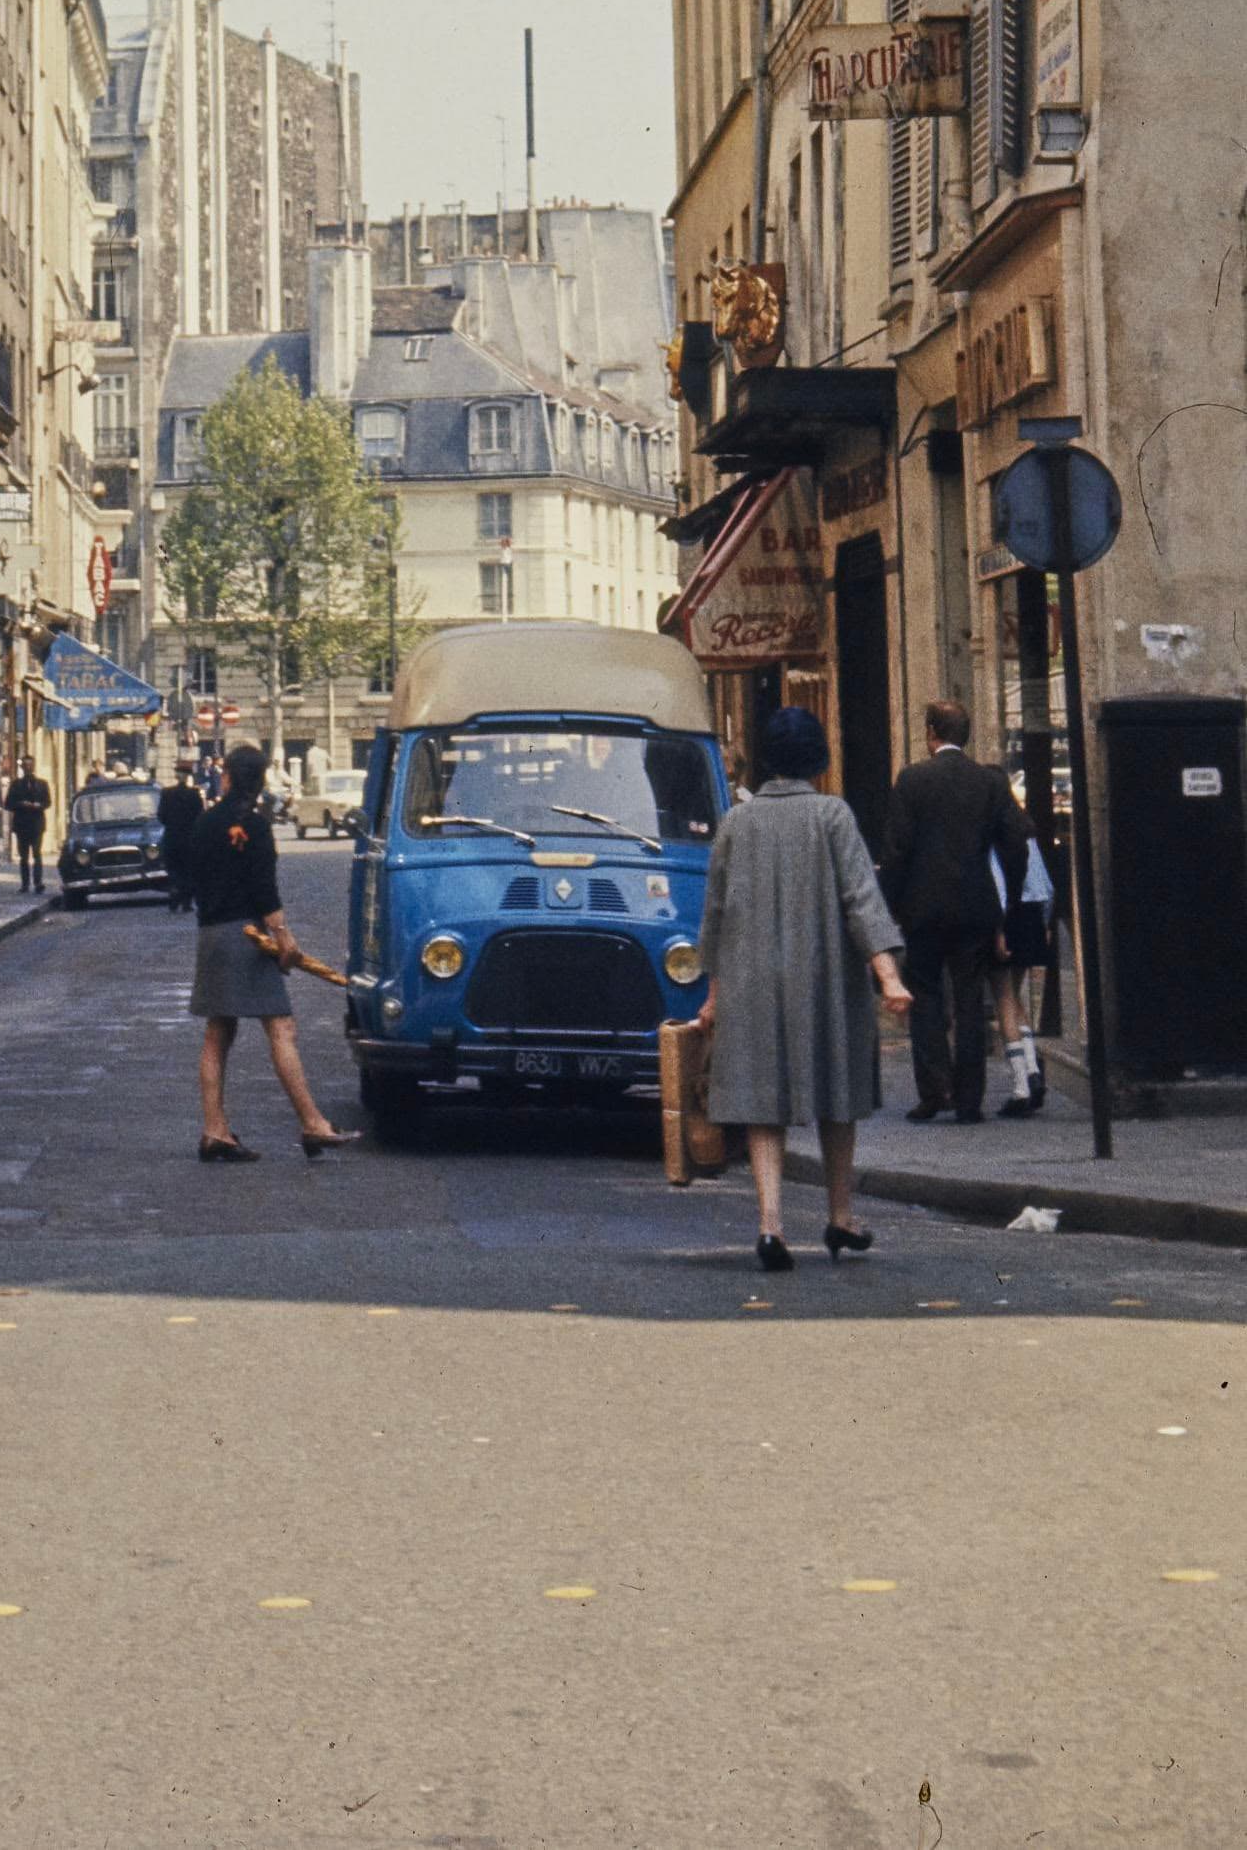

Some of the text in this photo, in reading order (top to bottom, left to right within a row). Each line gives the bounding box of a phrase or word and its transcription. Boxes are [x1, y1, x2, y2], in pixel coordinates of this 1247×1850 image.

[760, 527, 820, 552] BAR
[94, 541, 106, 607] TABAC
[58, 669, 126, 691] TABAC
